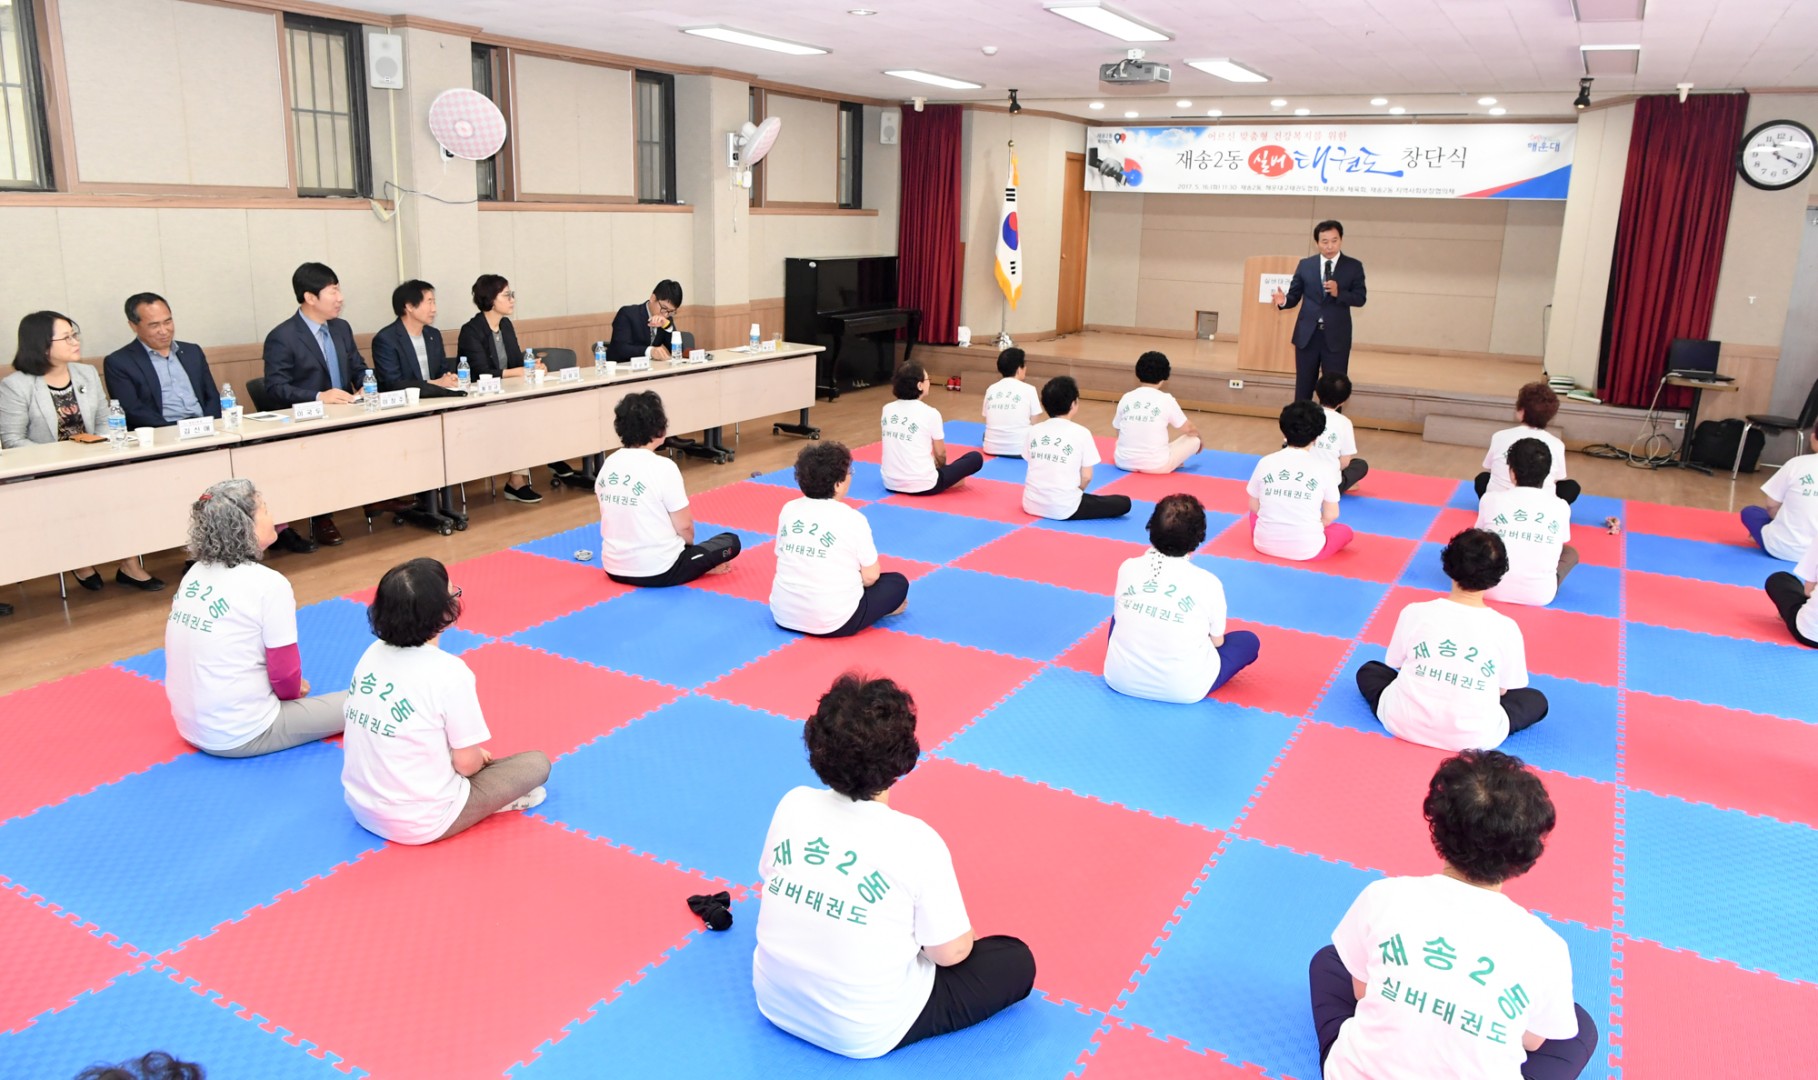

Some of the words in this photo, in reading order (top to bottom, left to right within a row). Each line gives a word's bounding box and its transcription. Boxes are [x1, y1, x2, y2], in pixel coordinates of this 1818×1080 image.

[1176, 149, 1243, 170] 재송2동
[1253, 150, 1286, 174] 실버
[1293, 145, 1404, 184] 태권도
[1401, 146, 1468, 169] 창단식
[1262, 469, 1318, 491] 재송2동
[1264, 487, 1312, 500] 실버태권도
[1493, 509, 1560, 534] 재송2동
[779, 543, 827, 558] 버태권도
[1498, 529, 1556, 544] 실버태권도
[168, 610, 213, 632] 버태권도
[1413, 639, 1496, 678] 재송2동
[1415, 664, 1487, 692] 실버태권도
[773, 837, 891, 904] 재송2동
[768, 875, 868, 925] 실버태권도
[1378, 933, 1531, 1020] 재송2동
[1380, 977, 1507, 1045] 실버태권도
